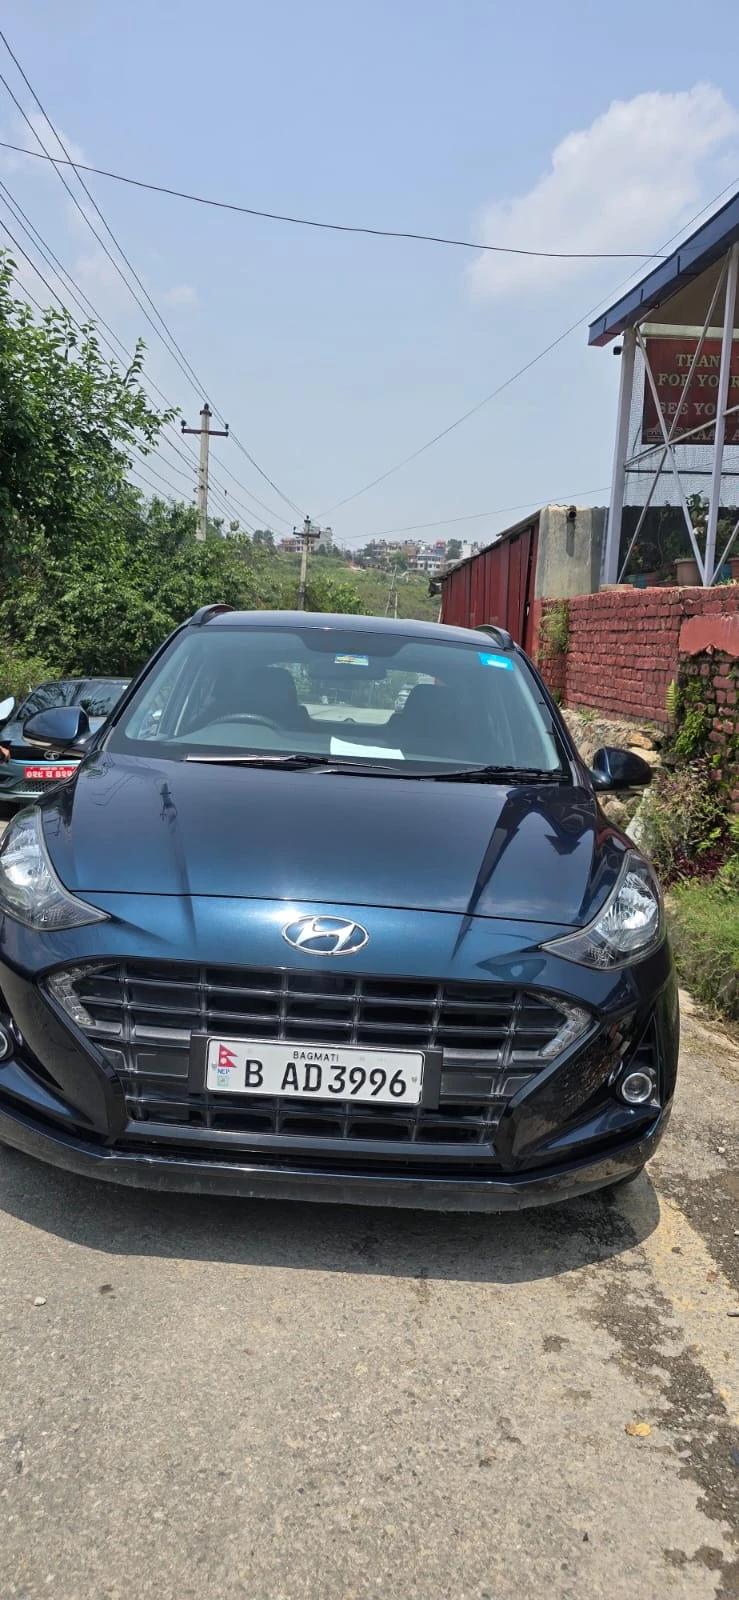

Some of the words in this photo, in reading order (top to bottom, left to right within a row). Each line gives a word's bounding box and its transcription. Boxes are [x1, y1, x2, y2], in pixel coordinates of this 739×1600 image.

[677, 354, 720, 368] THAN
[658, 374, 692, 387] FOR
[698, 374, 739, 388] YOR
[660, 402, 688, 415] SEE
[693, 402, 716, 415] YO
[293, 1050, 340, 1062] BAGMATI
[244, 1059, 264, 1088] B
[281, 1062, 407, 1098] AD3996
